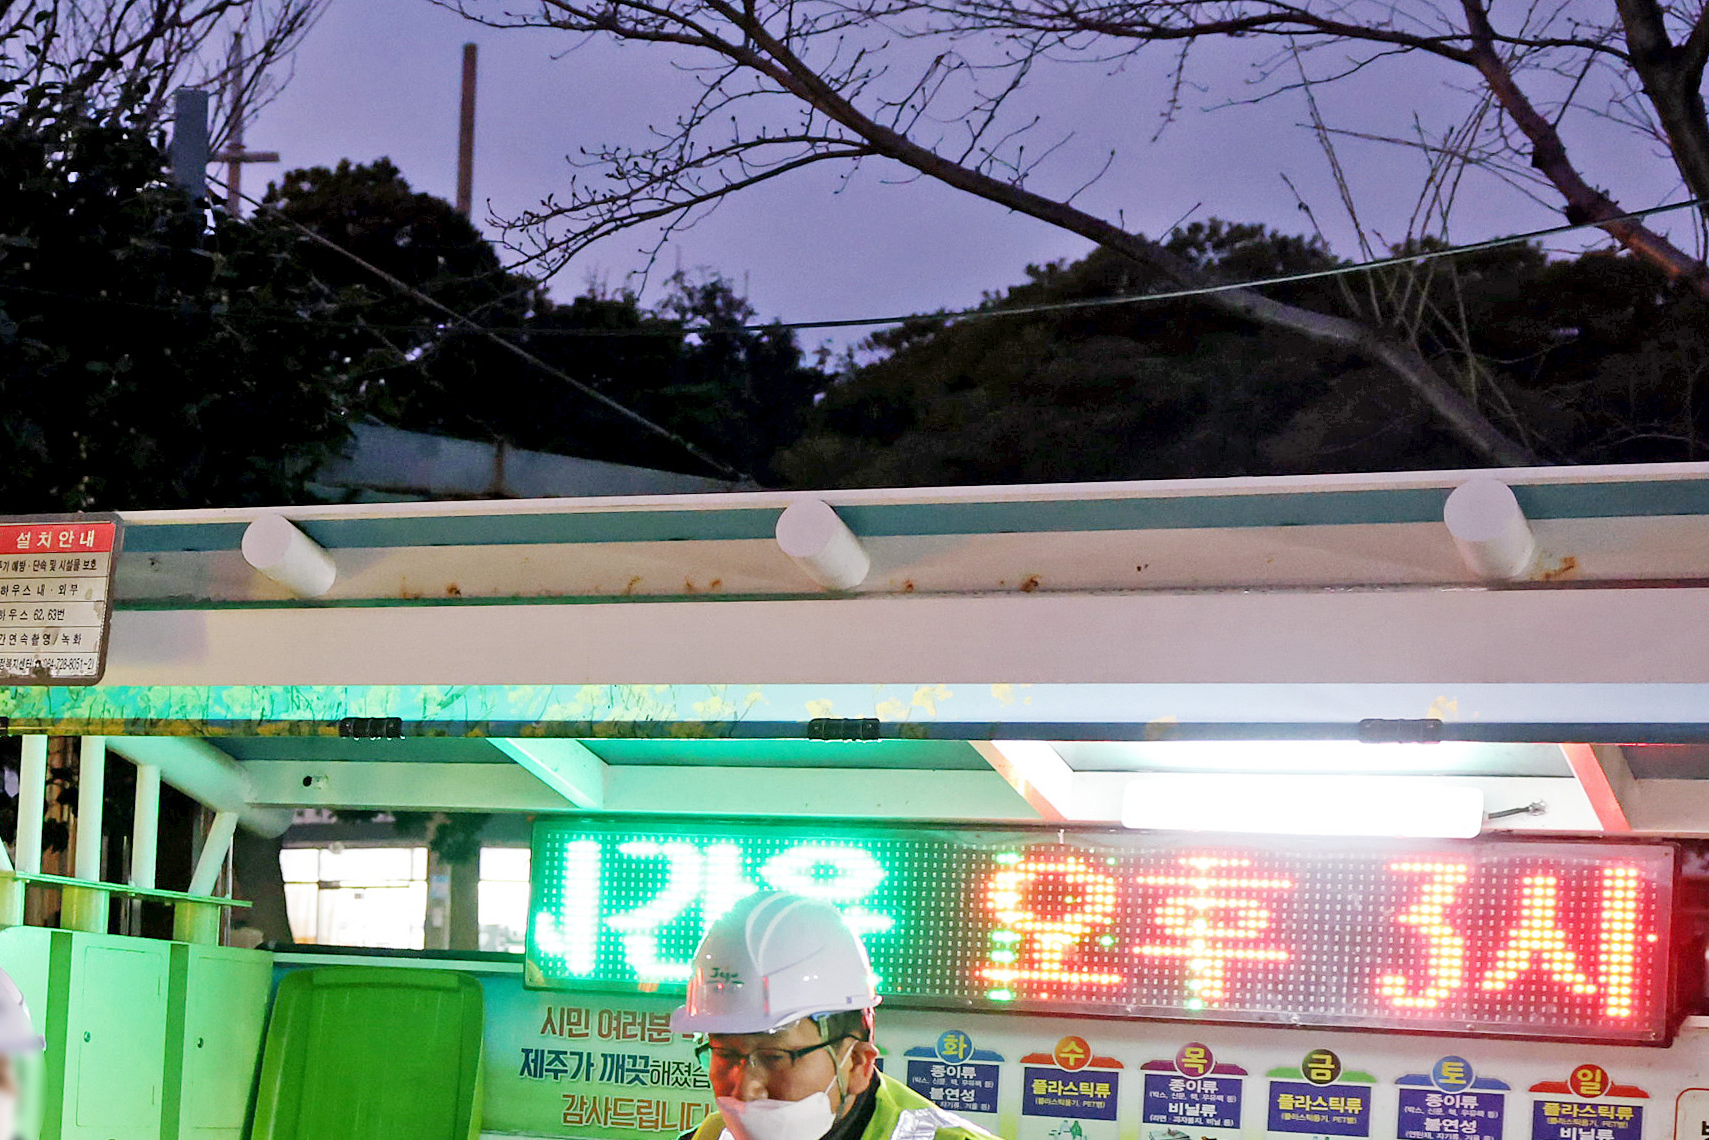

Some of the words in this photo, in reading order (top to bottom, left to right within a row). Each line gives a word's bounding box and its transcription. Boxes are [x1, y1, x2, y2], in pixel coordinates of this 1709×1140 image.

[16, 530, 95, 549] 설치안내
[32, 560, 47, 572] 단속
[49, 560, 56, 572] 및
[83, 559, 97, 571] 보호
[978, 855, 1294, 1003] 오후
[1378, 864, 1640, 1018] 3시
[540, 1006, 590, 1038] 시민
[597, 1008, 672, 1043] 여러분
[942, 1034, 968, 1059] 화
[1060, 1041, 1085, 1066] 수
[519, 1047, 595, 1082] 제주가
[1181, 1046, 1208, 1074] 목
[1307, 1054, 1335, 1081] 금
[930, 1064, 976, 1079] 종이류
[1439, 1061, 1467, 1084] 토
[1576, 1068, 1601, 1095] 일
[929, 1087, 975, 1102] 불연성
[1032, 1079, 1111, 1098] 플라스틱류
[1168, 1078, 1219, 1094] 종이류
[1168, 1102, 1218, 1118] 비닐류
[1277, 1093, 1363, 1115] 플라스틱류
[1425, 1093, 1479, 1109] 종이류
[1543, 1102, 1634, 1120] 플라스틱류
[1424, 1117, 1477, 1134] 불연성
